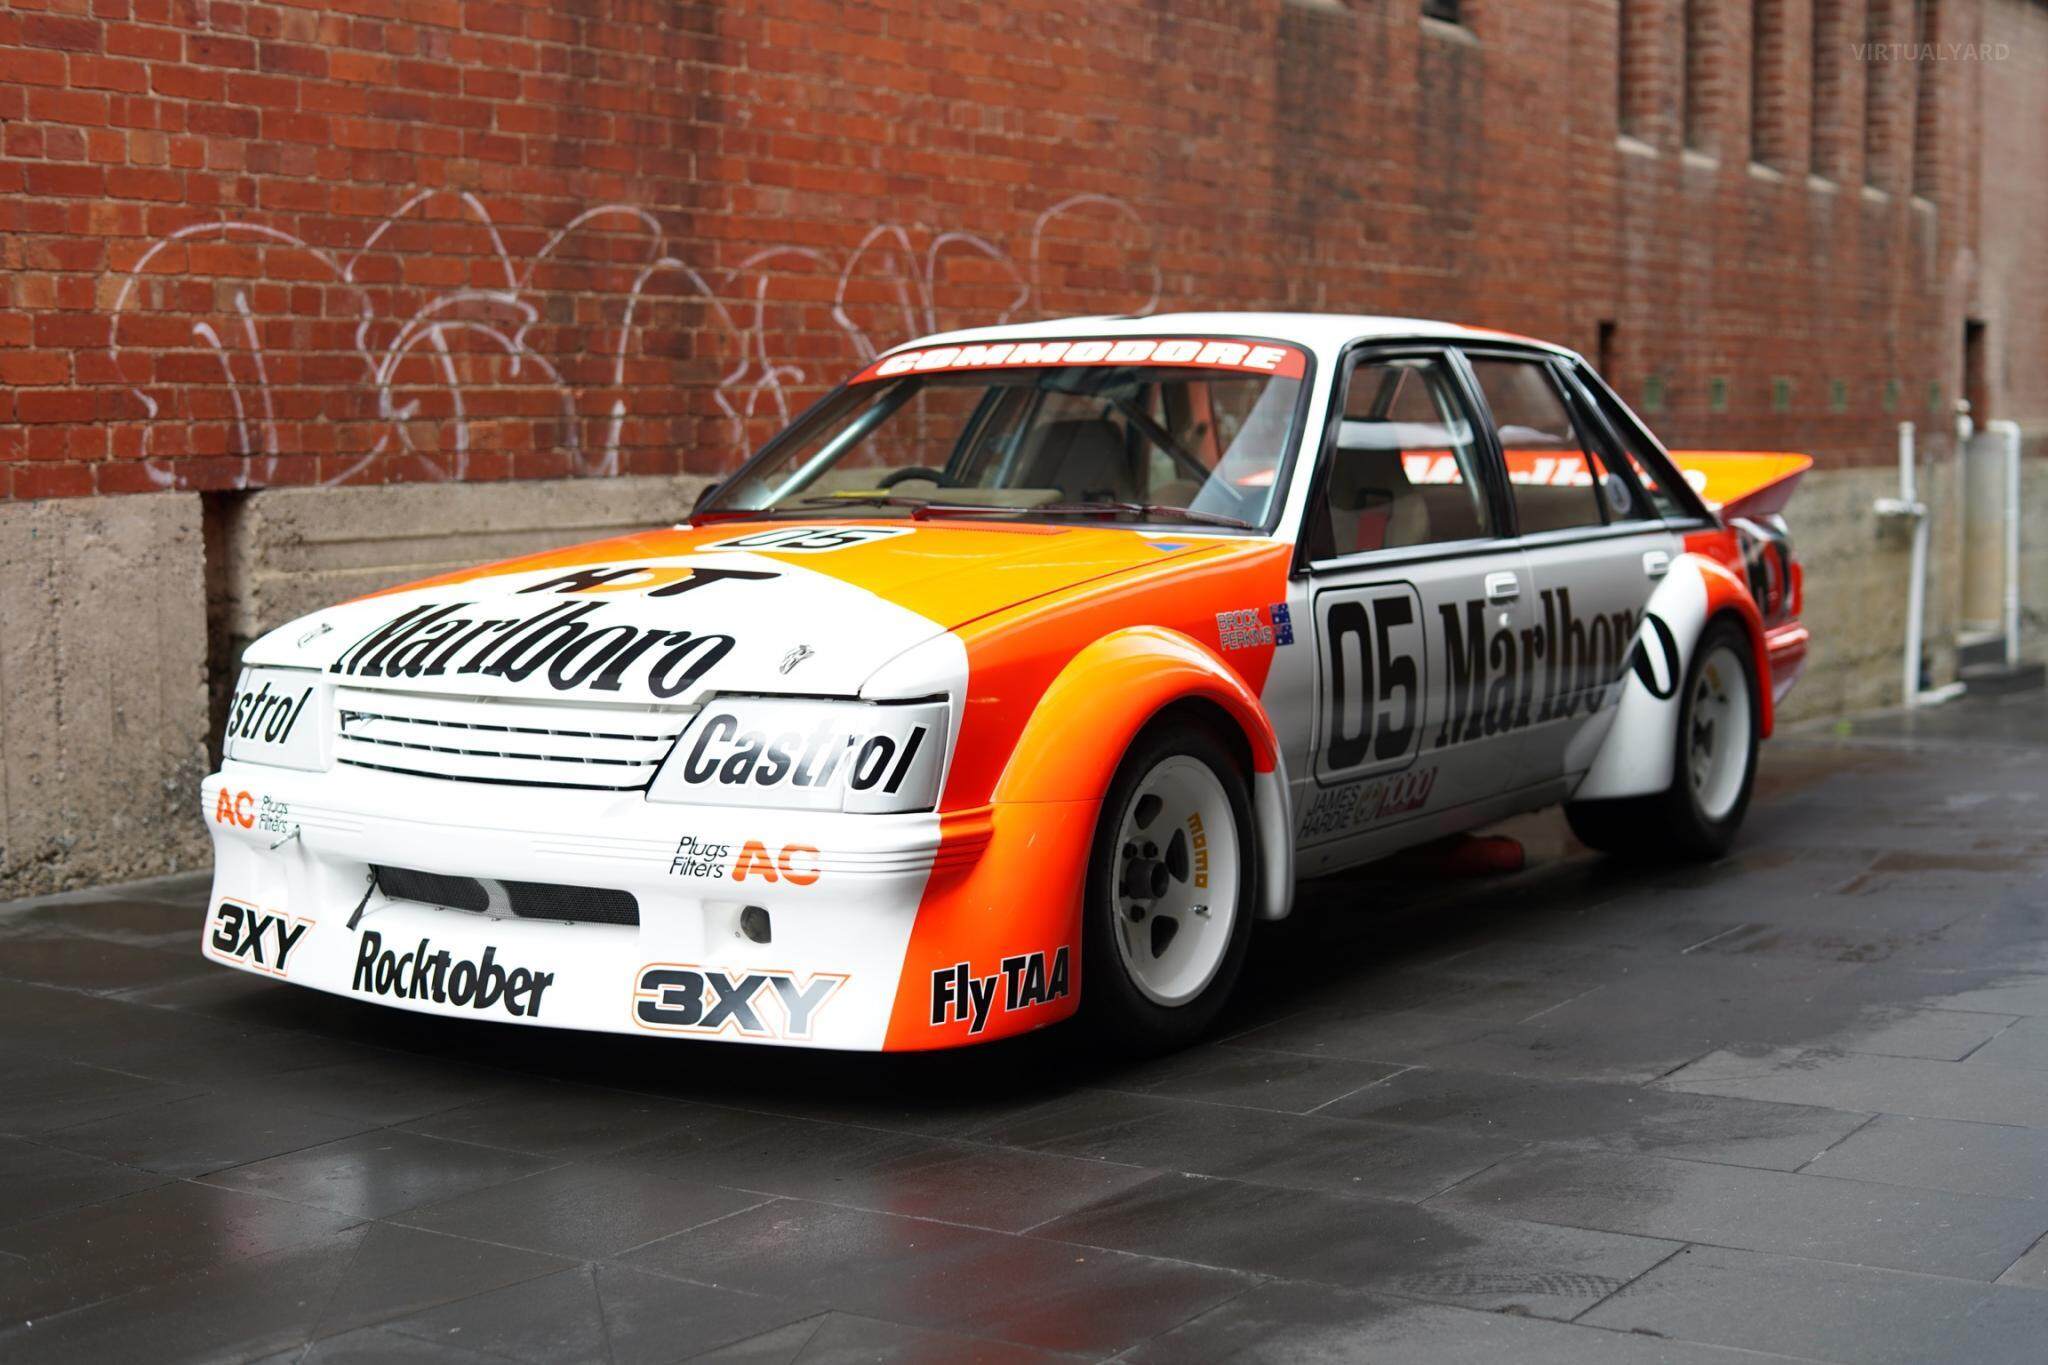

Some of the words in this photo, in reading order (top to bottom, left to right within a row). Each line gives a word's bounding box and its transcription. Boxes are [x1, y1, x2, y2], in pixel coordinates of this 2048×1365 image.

[875, 340, 1287, 376] COMMODORE
[716, 527, 897, 549] 05
[329, 600, 736, 698] Marlboro
[1327, 596, 1417, 770] 05
[684, 714, 927, 794] Castrol
[216, 787, 255, 829] AC
[259, 813, 288, 834] Filters
[262, 795, 288, 815] Plugs
[669, 857, 724, 879] Filters
[679, 836, 730, 863] Plugs
[731, 840, 821, 886] AC
[211, 902, 309, 971] 3XY
[352, 930, 554, 1017] Rocktober
[930, 961, 999, 1035] Fly
[1001, 945, 1069, 1012] TAA
[636, 968, 839, 1036] 3XY
